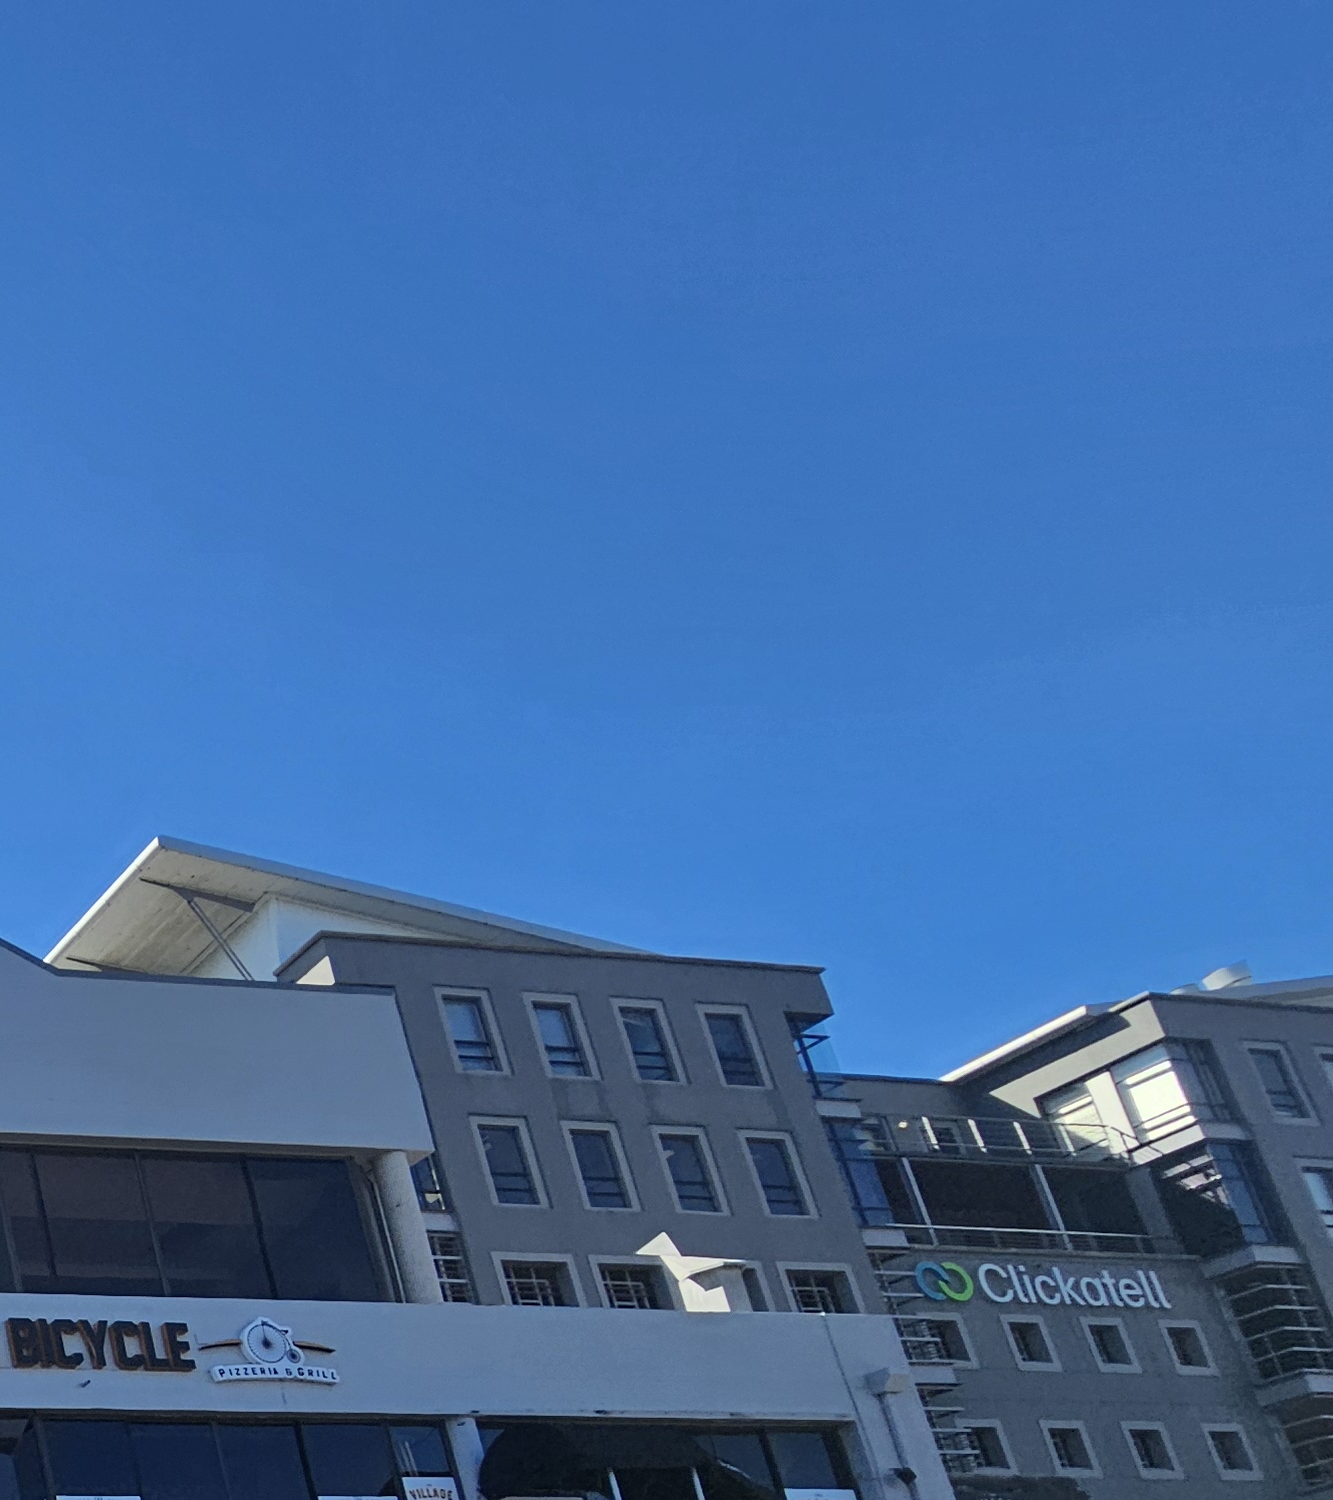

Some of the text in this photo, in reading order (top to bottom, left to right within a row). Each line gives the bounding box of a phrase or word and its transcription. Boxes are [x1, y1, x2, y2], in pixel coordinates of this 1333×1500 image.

[978, 1263, 1172, 1309] Clickatell
[5, 1317, 196, 1371] BICYCLE
[218, 1367, 278, 1378] PIZZERIA
[297, 1367, 336, 1380] GRILL
[409, 1488, 453, 1500] VILLAGE
